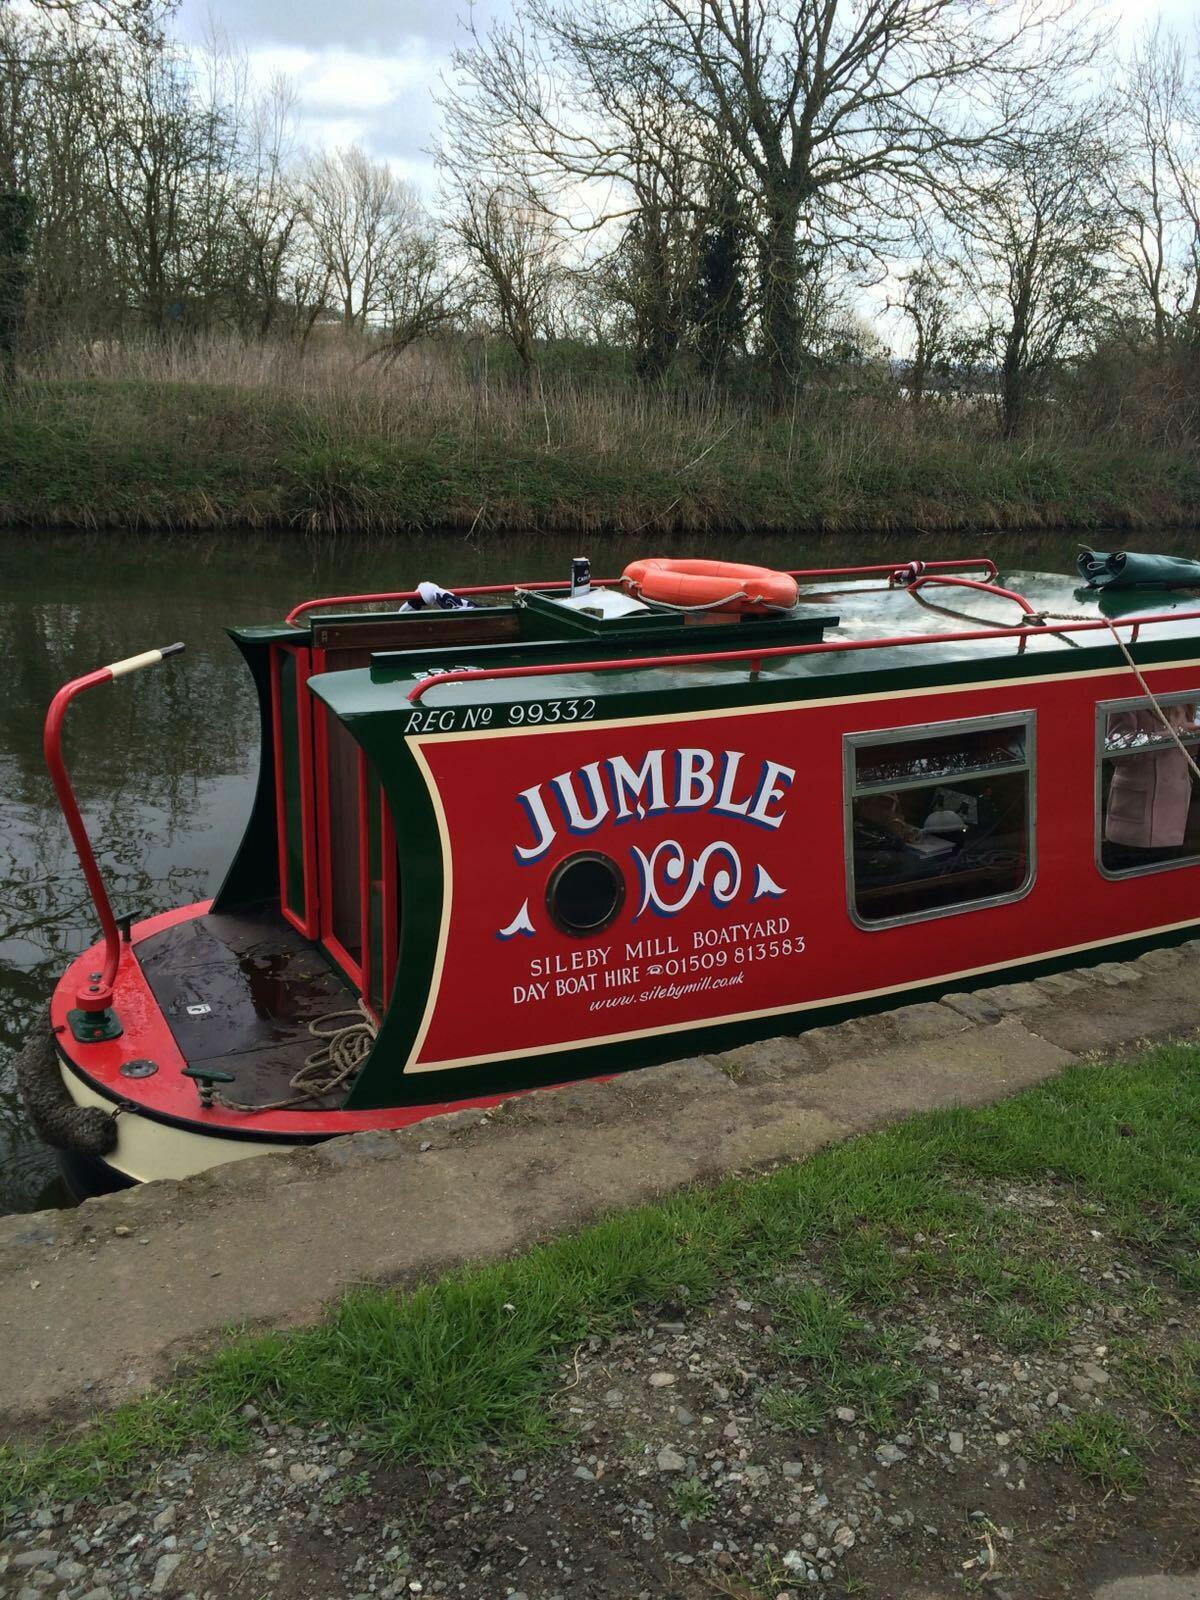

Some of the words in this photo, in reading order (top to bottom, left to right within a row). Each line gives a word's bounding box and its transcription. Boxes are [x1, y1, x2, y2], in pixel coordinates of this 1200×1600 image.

[404, 711, 456, 733] REG
[508, 699, 596, 725] 99332
[513, 748, 796, 867] JUMBLE
[512, 982, 549, 1004] DAY
[556, 973, 598, 997] BOAT
[605, 966, 640, 987] HIRE
[665, 951, 728, 976] 01509
[734, 936, 806, 963] 813583
[530, 946, 612, 977] SILEBY
[625, 936, 679, 962] MILL
[693, 917, 791, 949] BOATYARD
[589, 971, 744, 1012] www.silebymill.co.uk
